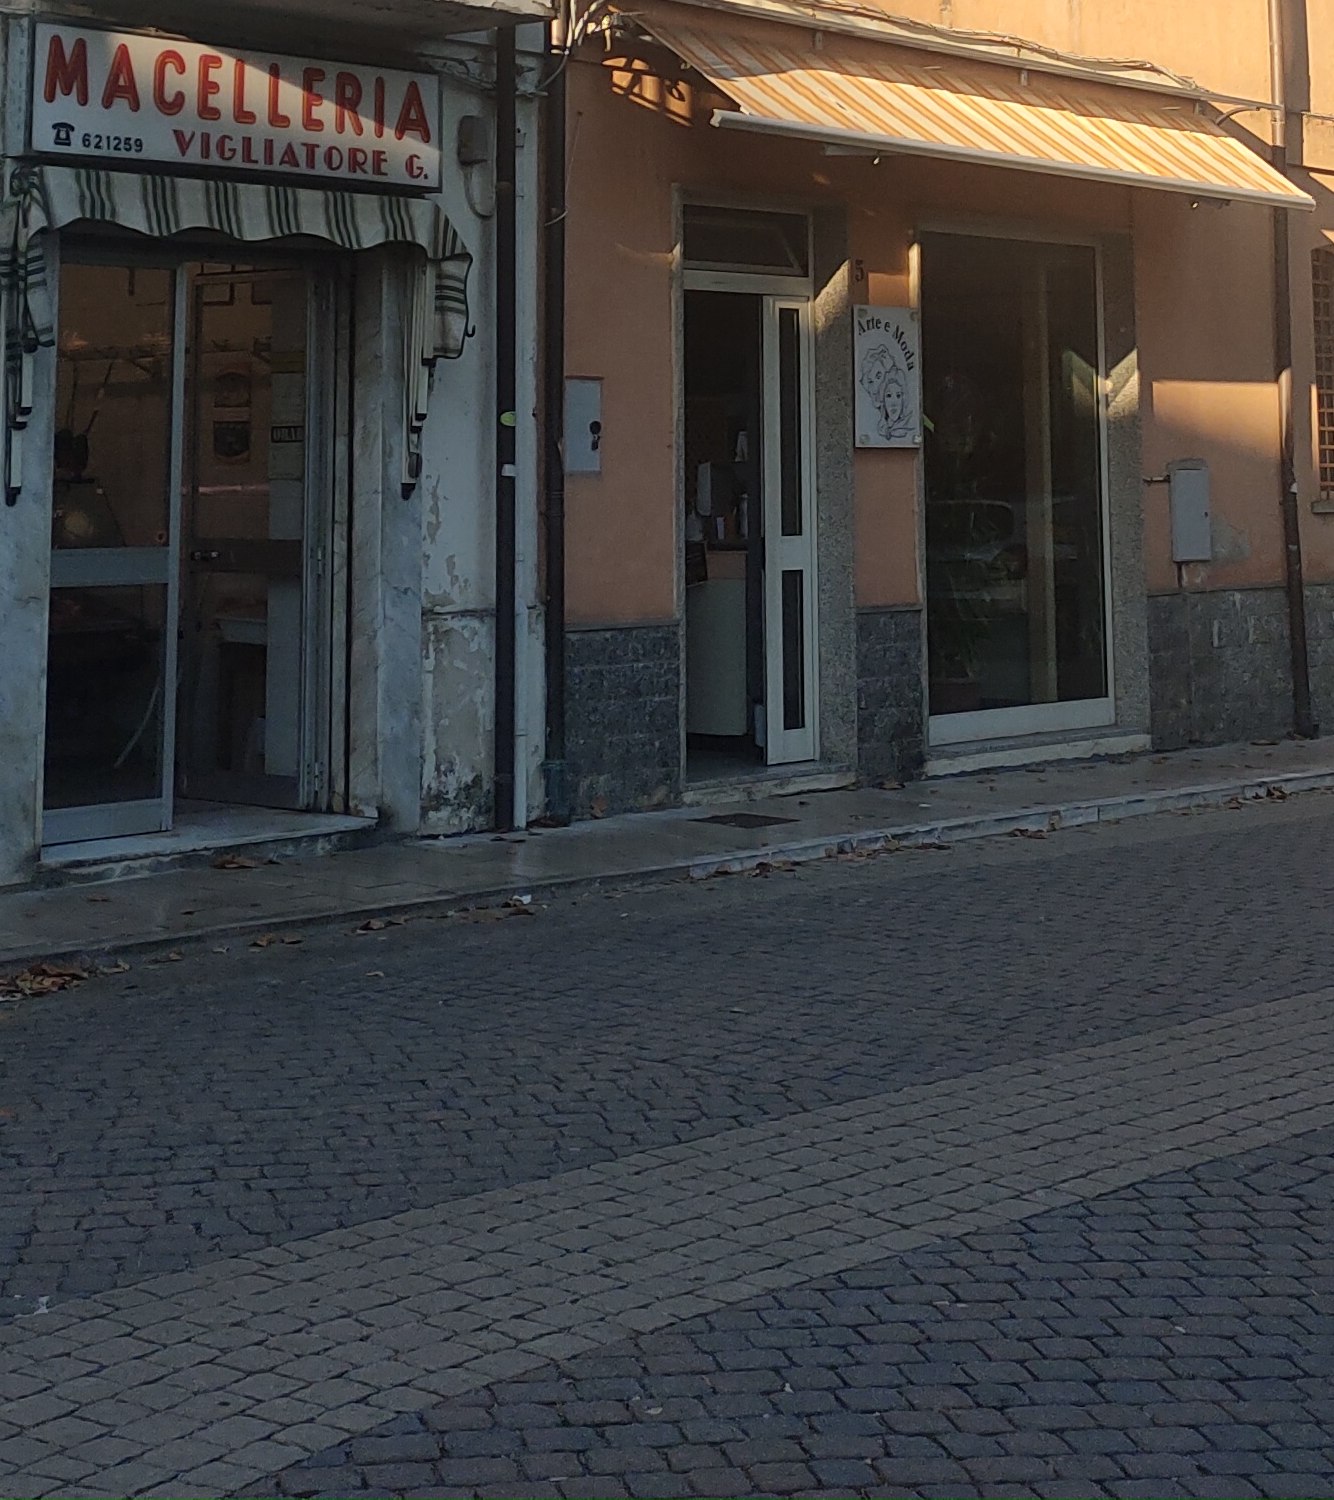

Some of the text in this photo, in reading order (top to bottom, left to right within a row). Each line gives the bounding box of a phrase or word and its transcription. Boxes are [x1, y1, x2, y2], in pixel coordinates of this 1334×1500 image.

[43, 34, 431, 143] MACELLERIA
[81, 133, 143, 153] 621259
[172, 129, 429, 180] VIGLIATORE G.
[857, 316, 915, 372] Arte e Moda
